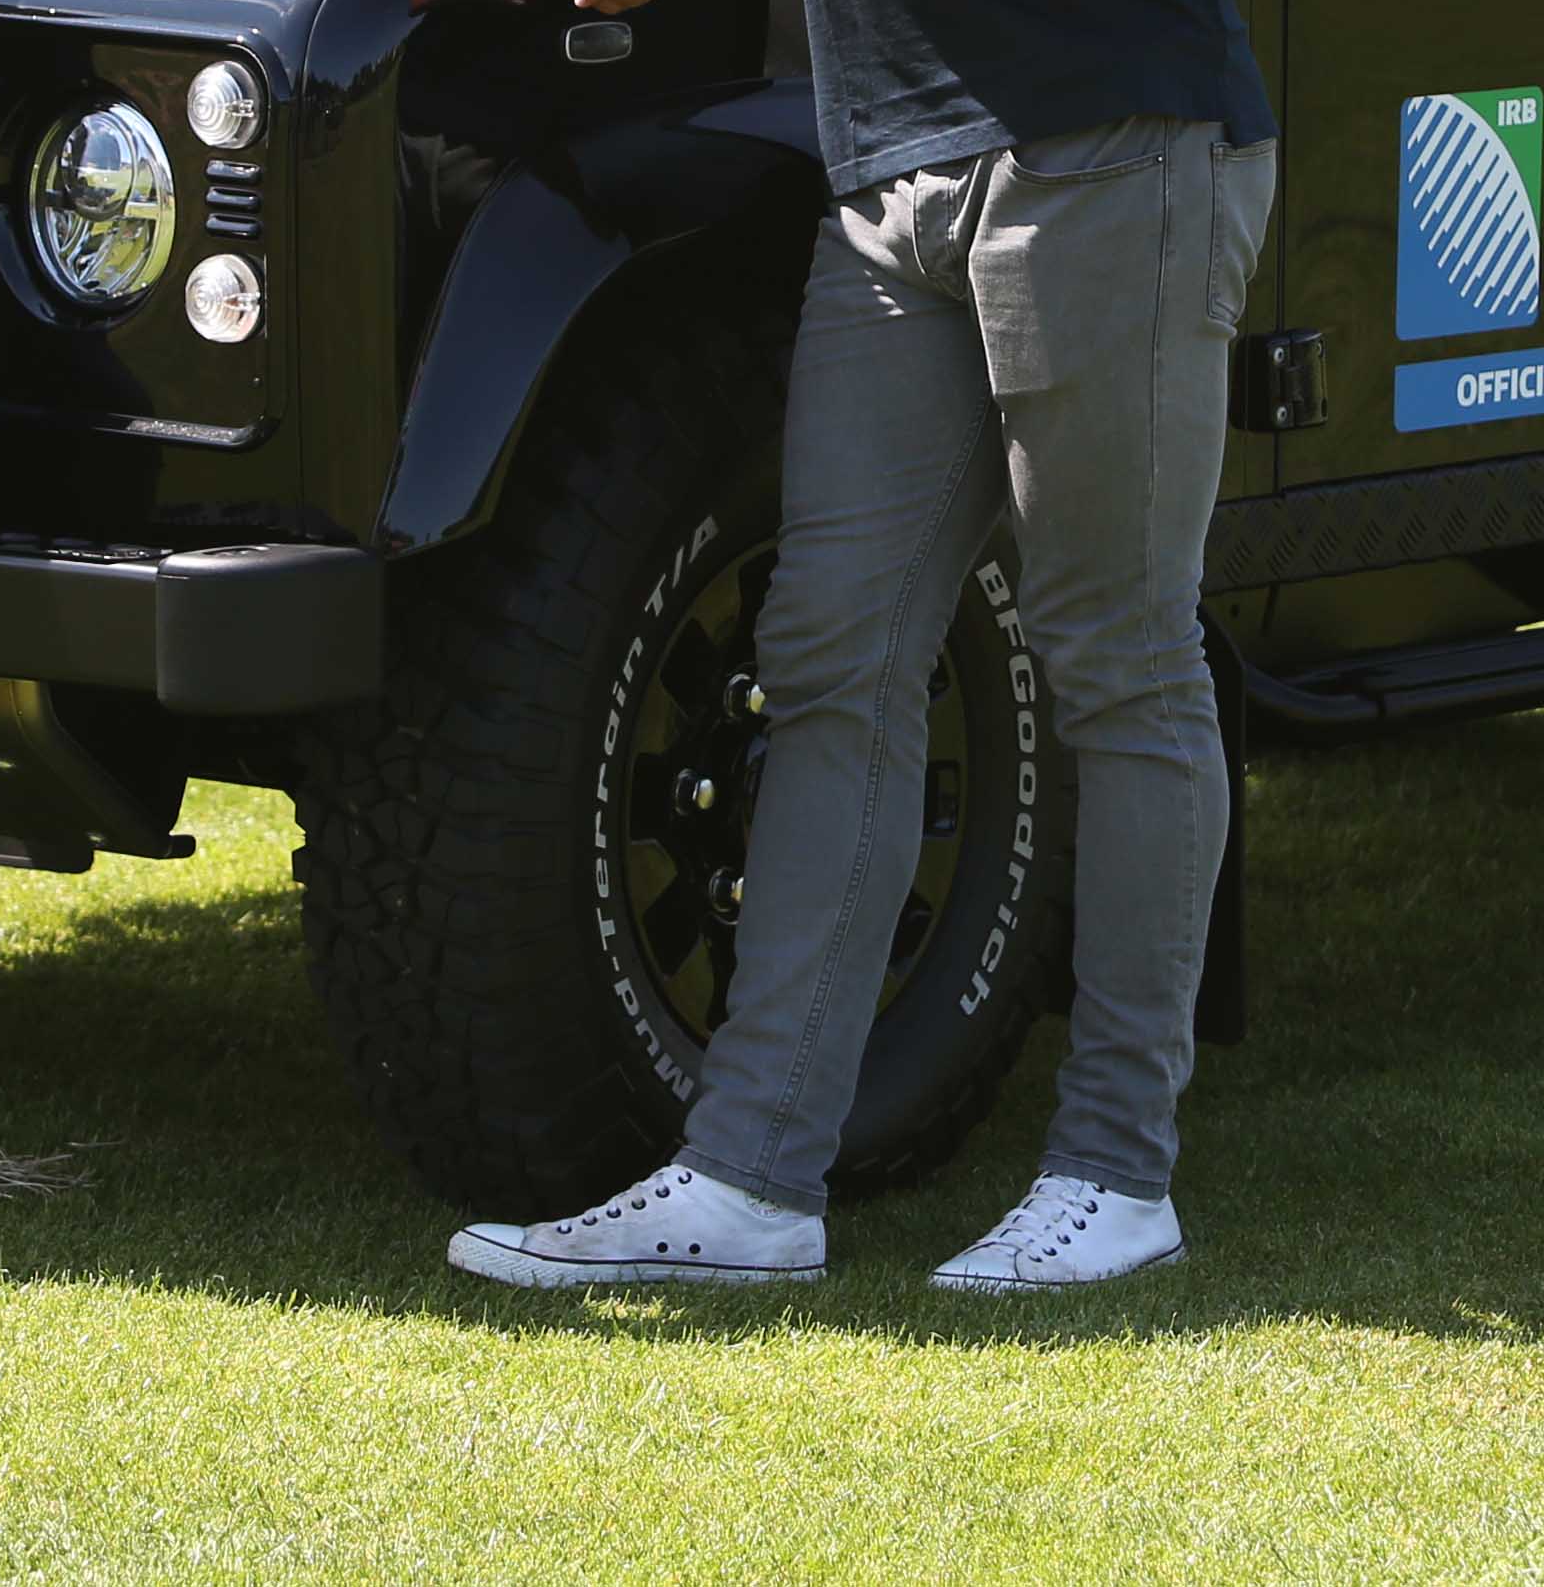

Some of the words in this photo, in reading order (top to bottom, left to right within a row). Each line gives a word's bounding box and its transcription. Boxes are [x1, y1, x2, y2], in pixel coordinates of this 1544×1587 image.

[1497, 98, 1538, 127] IRB
[592, 635, 695, 1102] Mud-Terrain
[959, 559, 1038, 1017] BFGoodrich
